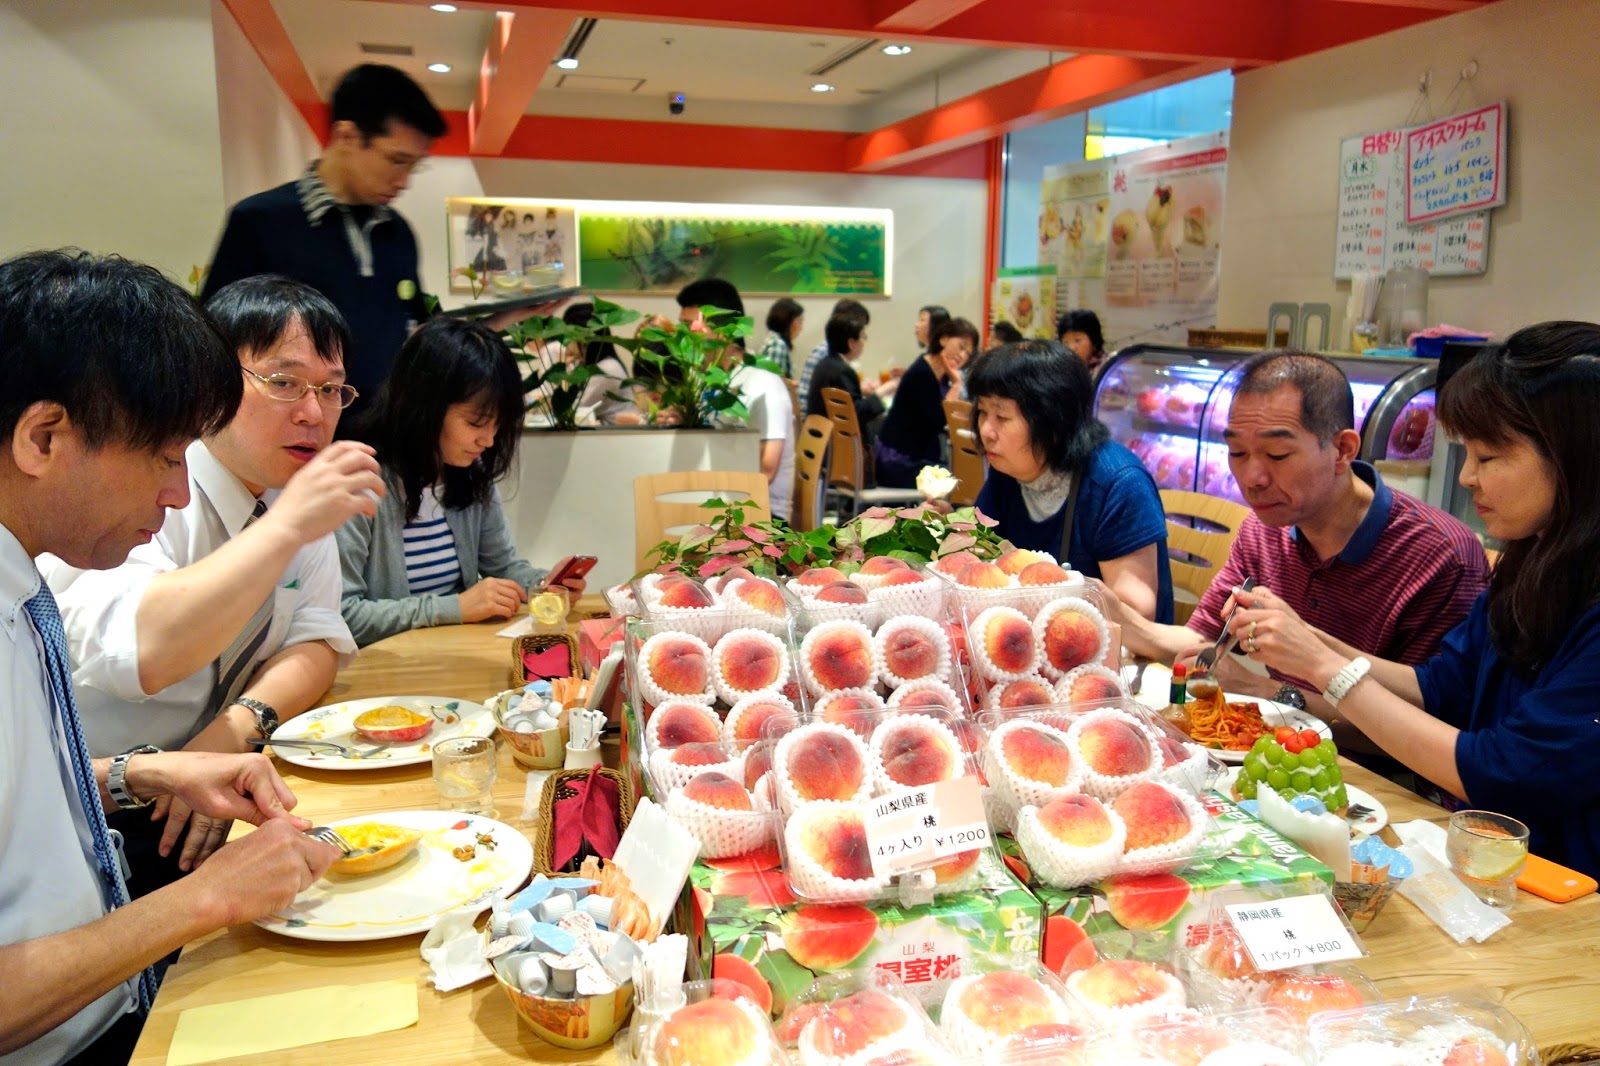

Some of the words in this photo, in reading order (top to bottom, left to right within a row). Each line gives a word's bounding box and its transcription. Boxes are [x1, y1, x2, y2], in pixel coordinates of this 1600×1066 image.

[1362, 130, 1402, 156] 日替り
[1413, 113, 1486, 153] アイスクリーム
[876, 792, 928, 818] 山梨県産
[923, 815, 937, 828] 桃
[935, 828, 986, 847] ¥1200
[1236, 907, 1284, 922] 静岡県産
[1282, 929, 1297, 941] 桃
[1261, 947, 1301, 963] 1パック
[1306, 940, 1342, 955] ¥800
